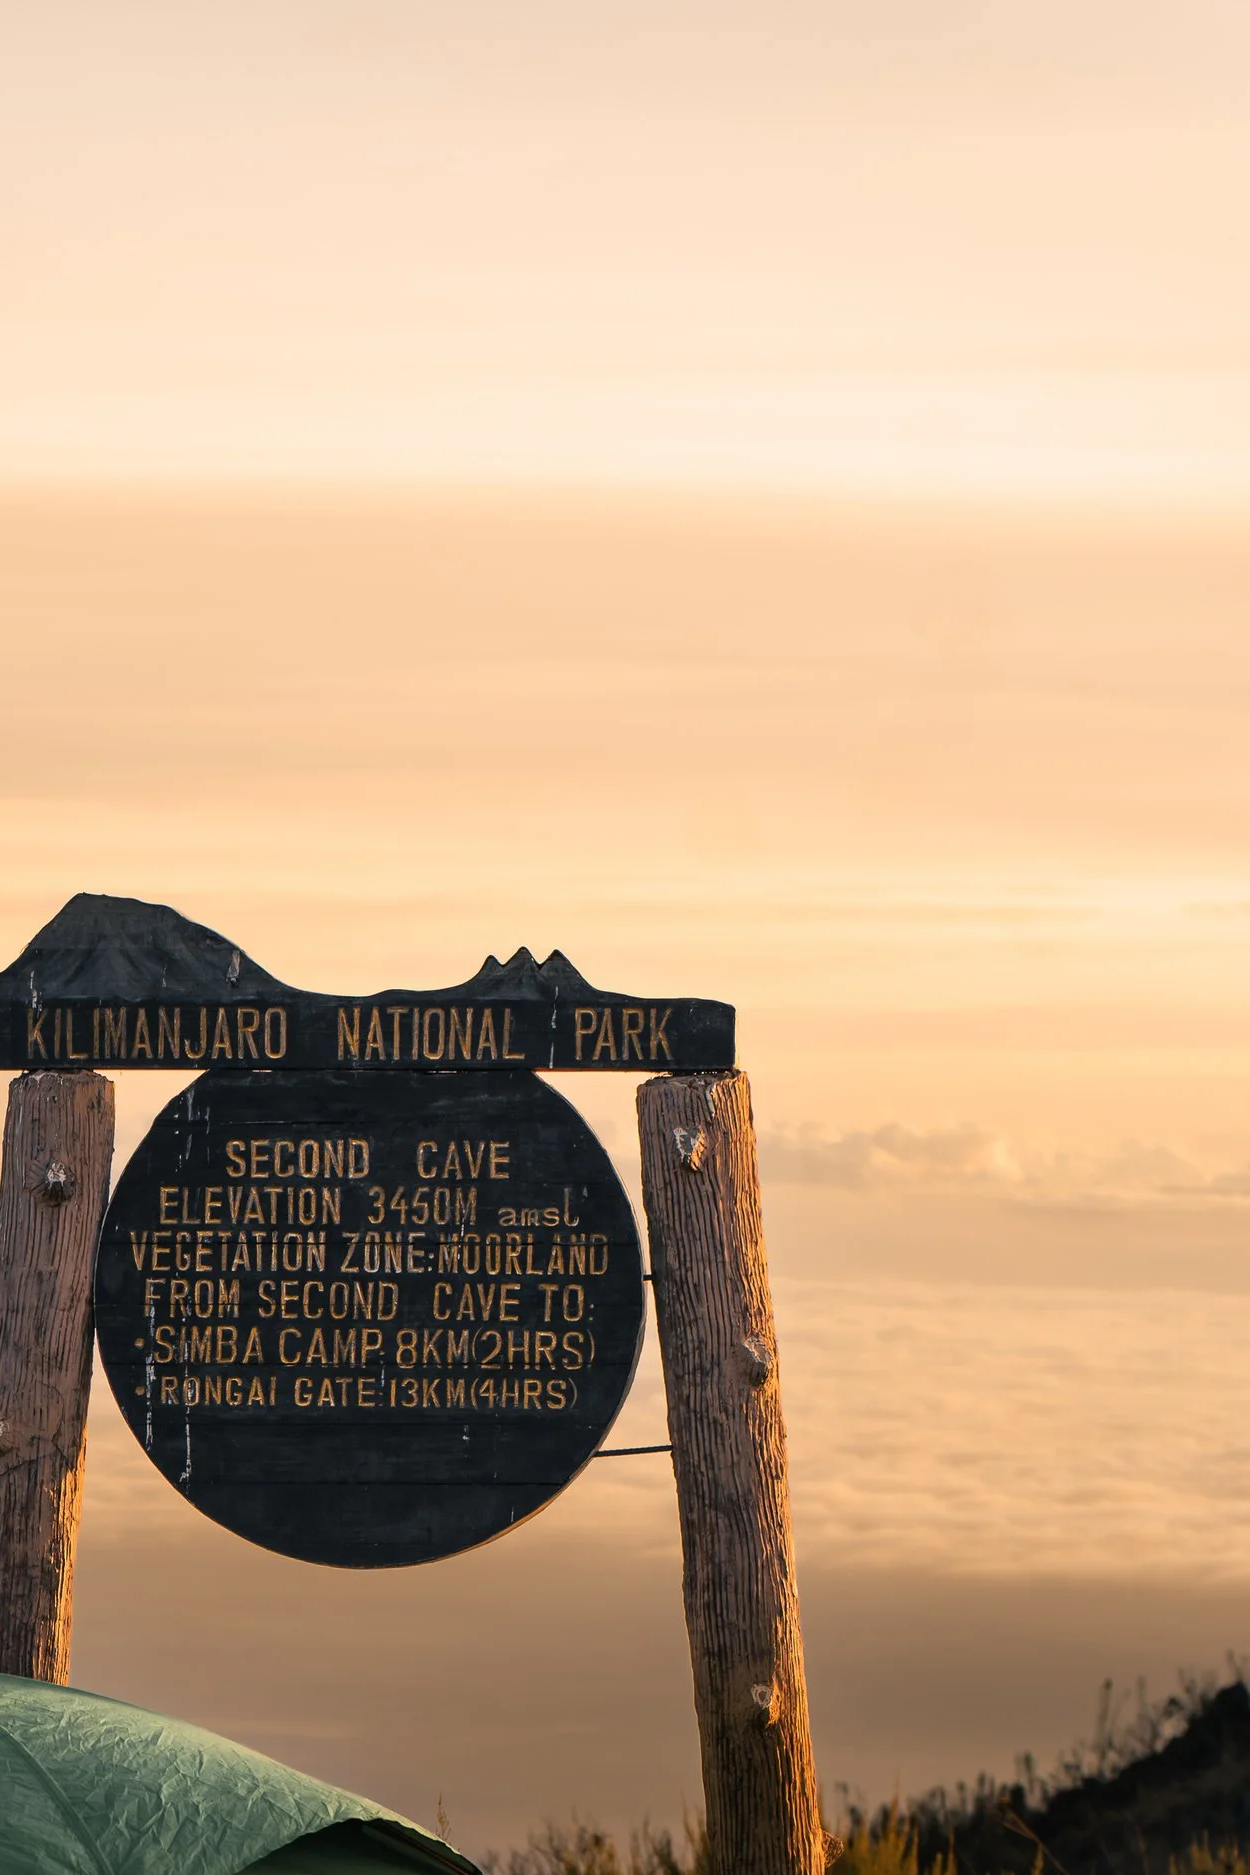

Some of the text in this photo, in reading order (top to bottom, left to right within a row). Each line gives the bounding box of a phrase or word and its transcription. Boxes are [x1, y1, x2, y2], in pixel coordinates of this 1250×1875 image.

[26, 1006, 674, 1061] KILIMANJARO NATIONAL PARK
[225, 1139, 510, 1180] SECOND CAVE
[159, 1186, 341, 1226] ELEVATION
[368, 1186, 478, 1226] 3450M
[130, 1230, 326, 1273] VEGETATION
[144, 1277, 240, 1319] FROM
[258, 1280, 399, 1321] SECOND
[432, 1282, 521, 1321] CAVE
[153, 1325, 265, 1365] SIMBA
[160, 1375, 277, 1407] RONGAI
